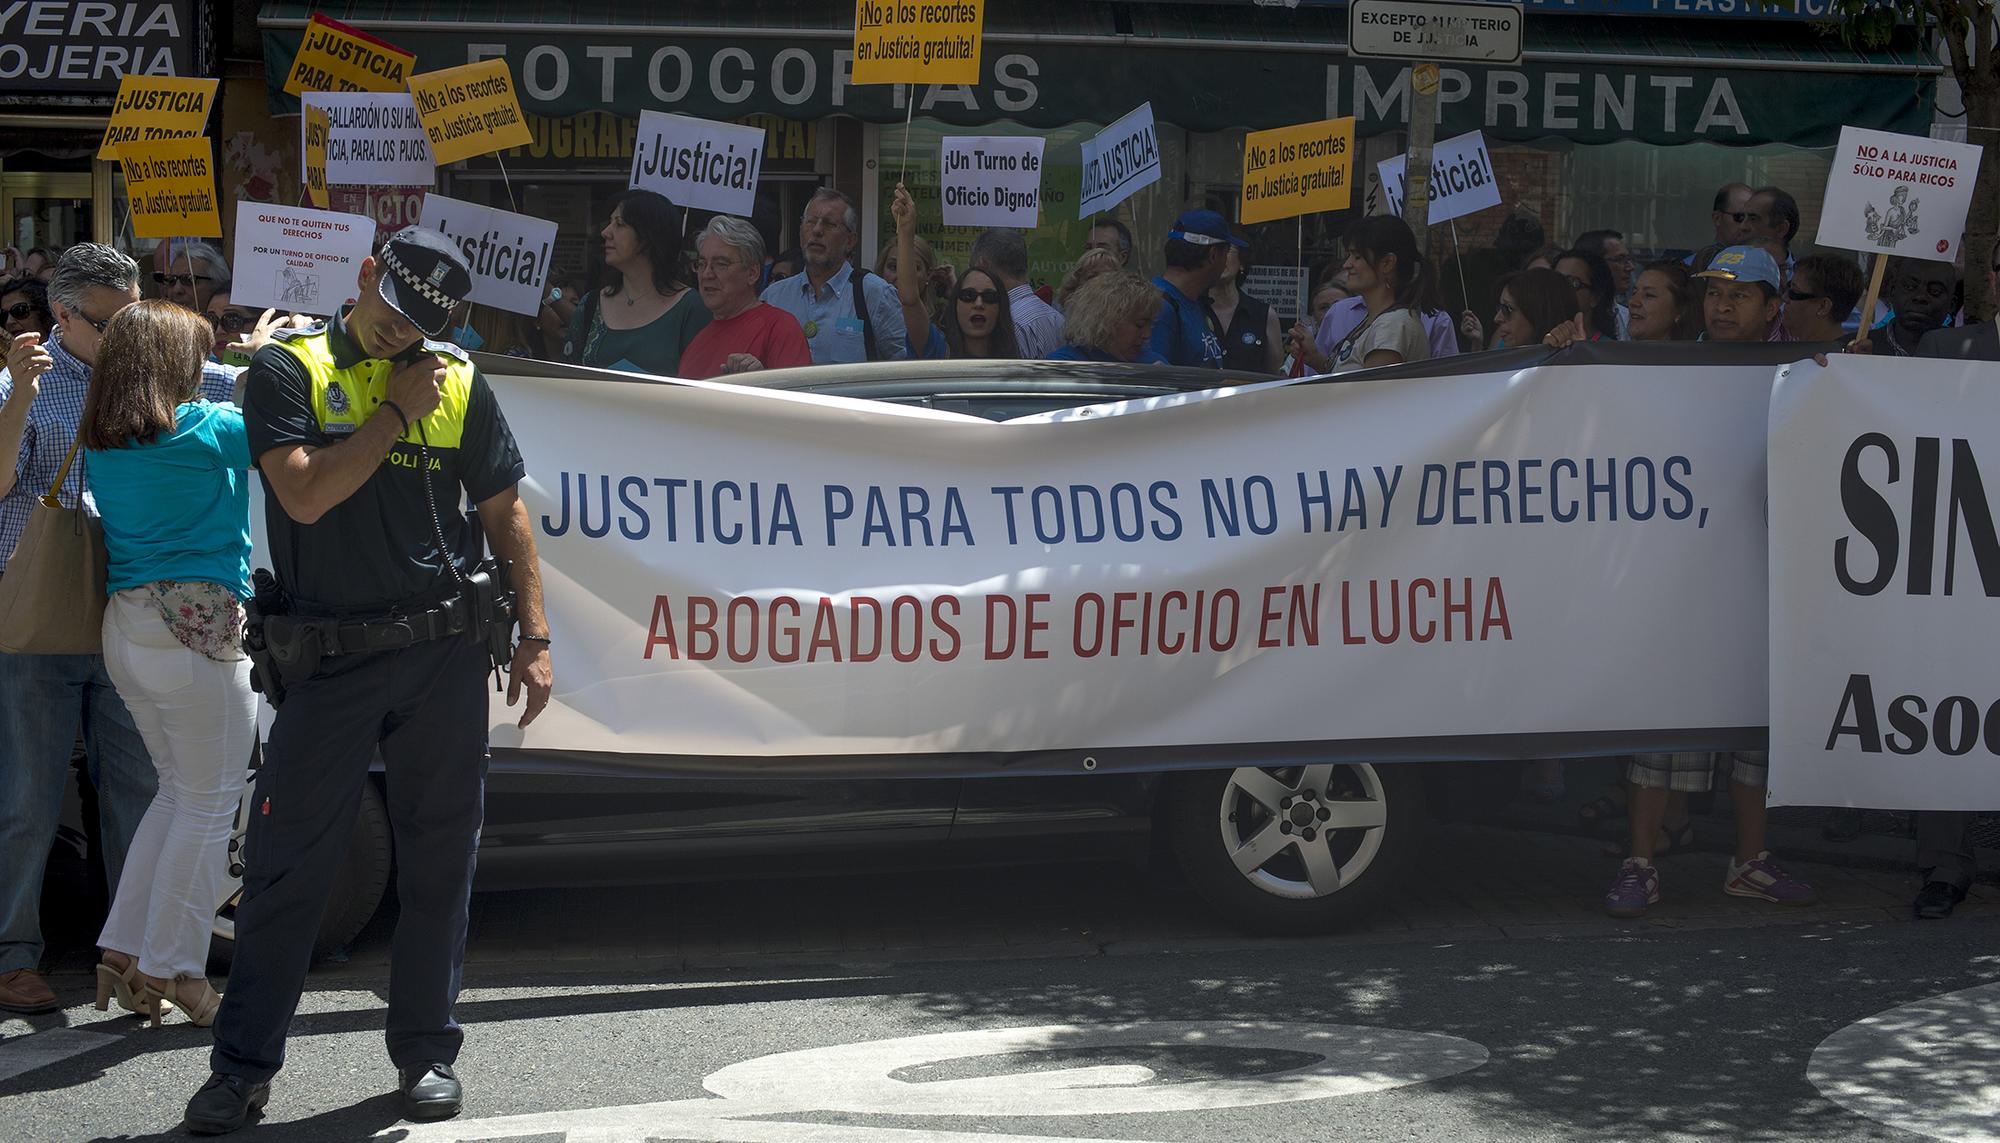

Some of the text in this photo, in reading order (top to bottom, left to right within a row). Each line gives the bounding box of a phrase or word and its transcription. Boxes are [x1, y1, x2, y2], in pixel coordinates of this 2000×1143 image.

[860, 0, 976, 30] ¡No a los recortes
[1361, 12, 1426, 27] EXCEPTO
[858, 34, 975, 65] en Justicia gratuita!
[1393, 31, 1411, 43] DE
[304, 32, 404, 83] ¡JUSTICIA
[294, 62, 332, 91] PARA
[115, 89, 204, 114] ¡JUSTICIA
[416, 75, 508, 118] ¡No a los recortes
[1325, 64, 1750, 135] IMPRENTA
[382, 107, 389, 130] O
[391, 107, 404, 130] SU
[428, 102, 519, 144] en Justicia gratuita!
[105, 126, 139, 146] PARA
[351, 139, 376, 161] PARA
[377, 139, 396, 162] LOS
[399, 139, 428, 162] PIJOS.
[634, 133, 758, 190] ¡Justicia!
[944, 150, 1039, 175] ¡Un Turno de
[1103, 123, 1158, 190] JUSTICIA!
[1247, 135, 1346, 174] ¡No a los recortes
[1857, 145, 1957, 170] NO A LA JUSTICIA
[124, 154, 207, 186] ¡No a los recortes
[1246, 163, 1345, 201] en Justicia gratuita!
[1852, 162, 1955, 188] SÓLO PARA RICOS
[132, 188, 213, 219] en Justicia gratuita!
[945, 186, 1038, 213] Oficio Digno!
[258, 214, 350, 232] QUE NO TE QUITEN TUS
[282, 228, 322, 240] DERECHOS
[253, 246, 350, 264] POR UN TURNO DE OFICIO DE
[285, 259, 314, 269] CALIDAD
[385, 451, 442, 472] OLIIA
[541, 455, 1710, 548] JUSTICIA PARA TODOS NO HAY DERECHOS,
[643, 576, 1514, 663] ABOGADOS DE OFICIO EN LUCHA
